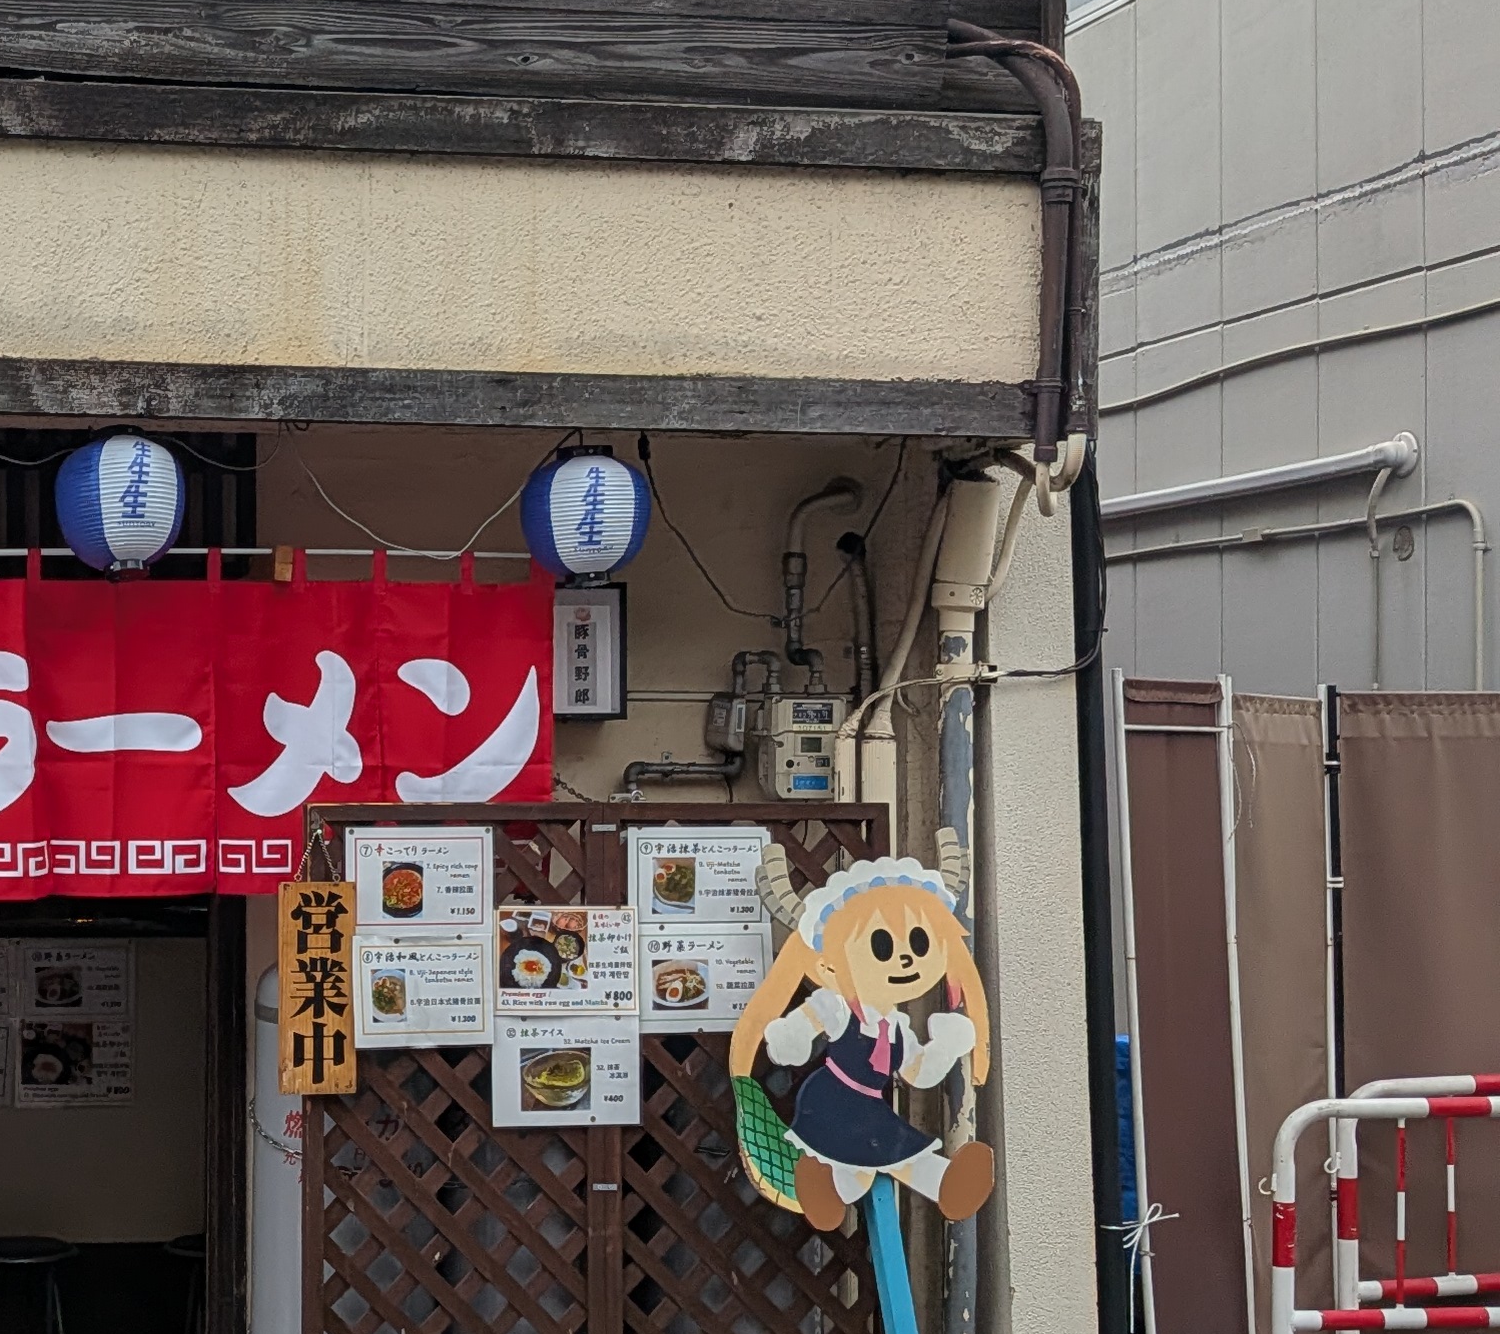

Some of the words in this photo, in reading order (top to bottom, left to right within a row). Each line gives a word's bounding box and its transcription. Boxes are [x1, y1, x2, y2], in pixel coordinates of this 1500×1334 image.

[575, 624, 589, 704] 豚骨野郎
[433, 863, 449, 871] Spicy
[662, 940, 724, 953] 野菜ラーメン
[290, 890, 349, 1084] 営業中
[604, 991, 633, 1000] ¥800
[520, 1028, 564, 1038] 抹茶アイス
